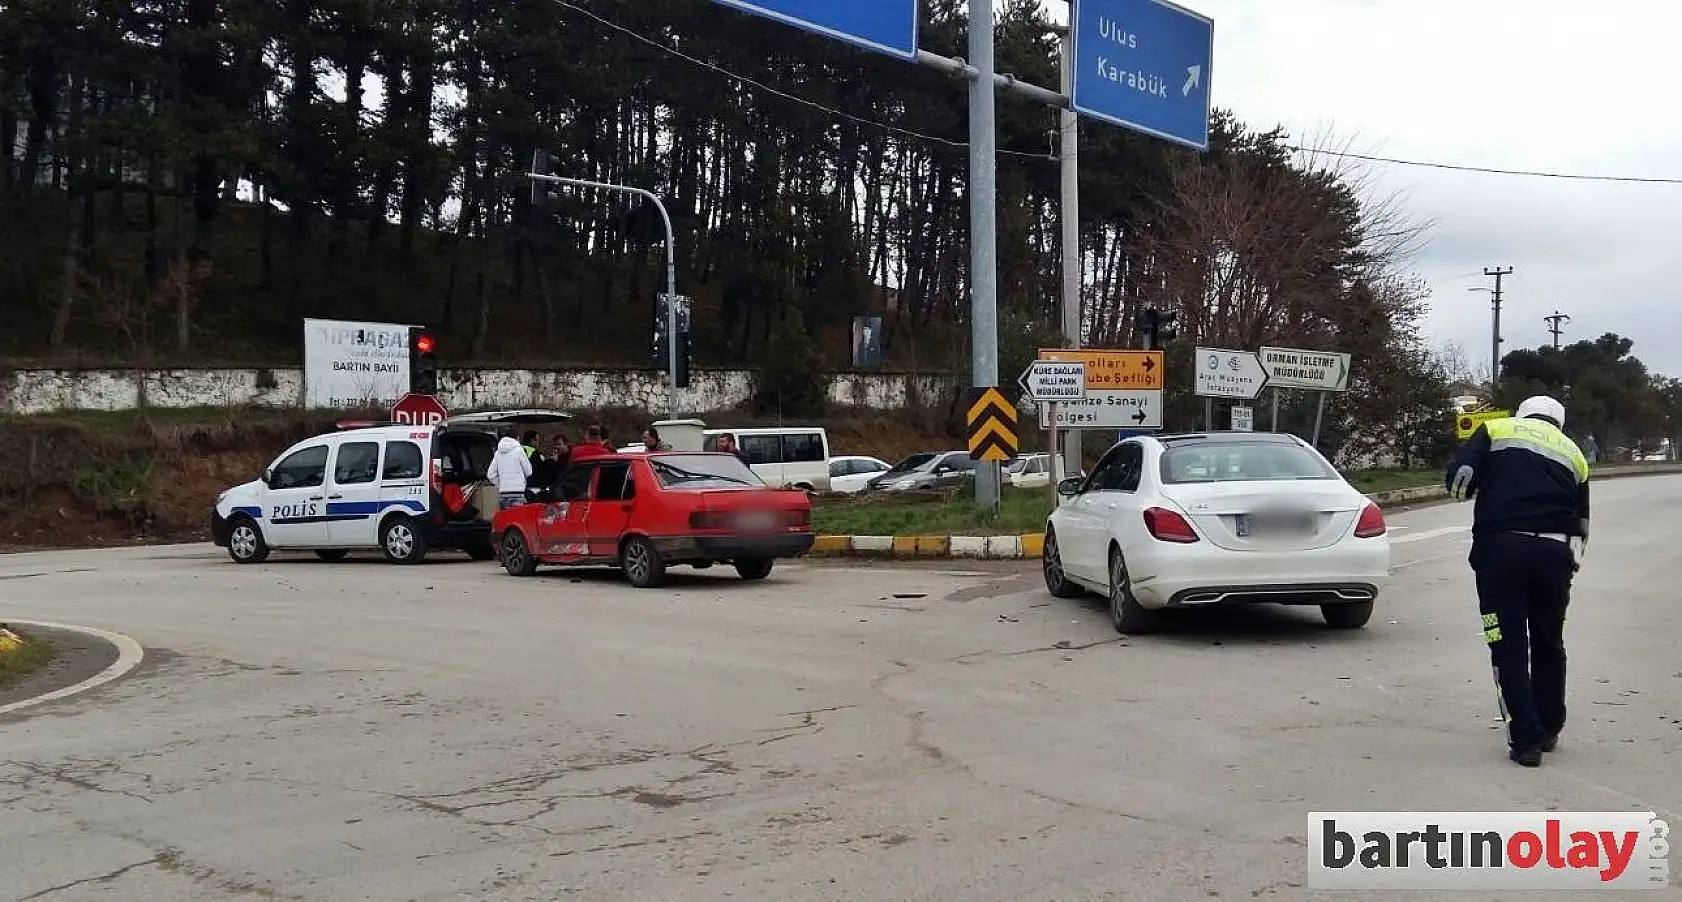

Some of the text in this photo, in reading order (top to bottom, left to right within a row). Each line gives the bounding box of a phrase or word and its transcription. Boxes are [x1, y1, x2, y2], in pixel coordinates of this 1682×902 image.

[1099, 16, 1137, 49] Ulus
[1097, 55, 1168, 99] Karabük
[1088, 357, 1125, 369] olları
[1266, 352, 1298, 365] ORMAN
[333, 361, 370, 372] BARTIN
[1059, 377, 1077, 386] PARK
[1087, 373, 1110, 384] ube
[1107, 395, 1148, 408] Sanayi
[272, 500, 316, 518] POLİS
